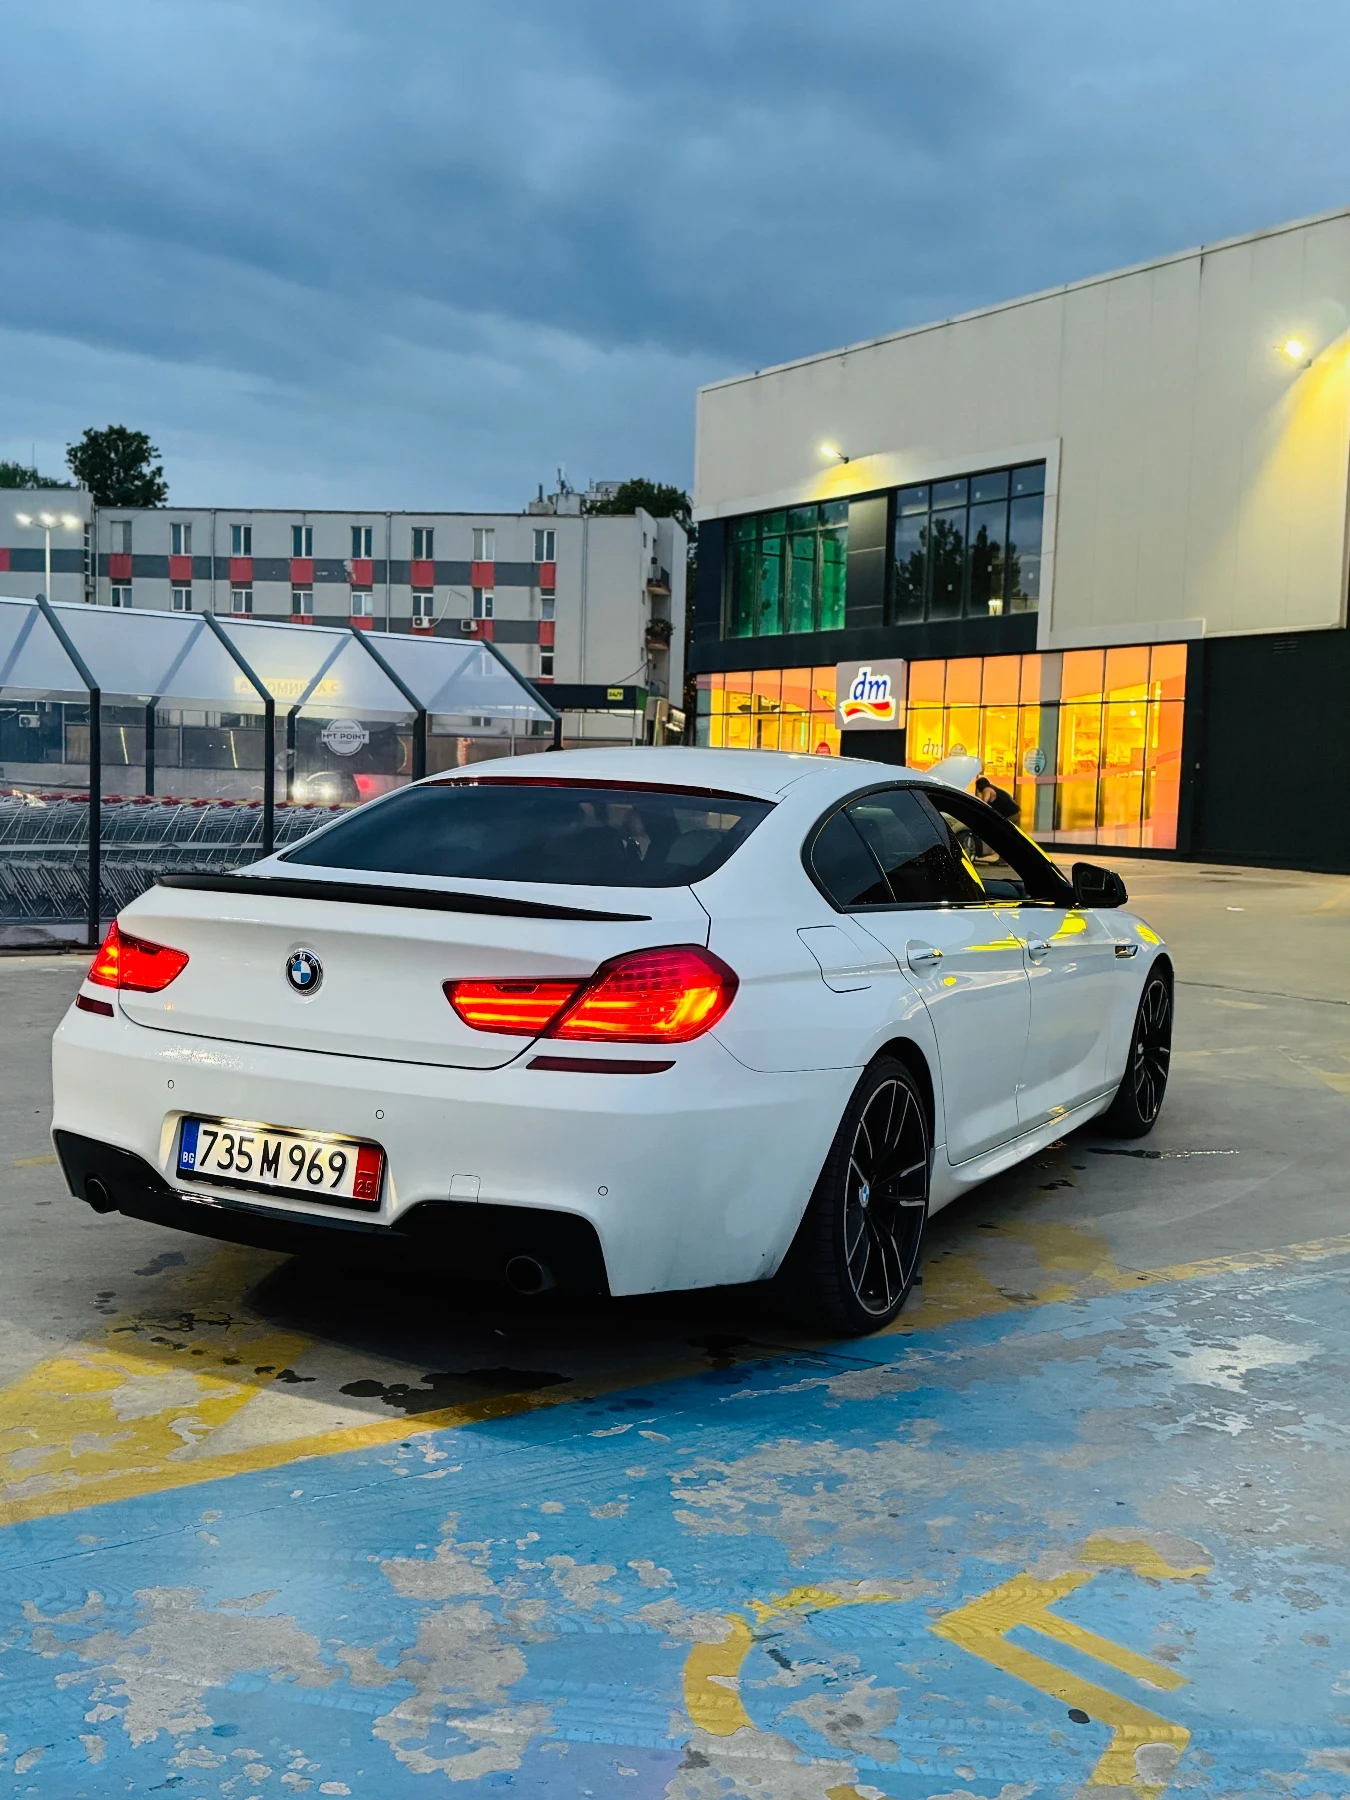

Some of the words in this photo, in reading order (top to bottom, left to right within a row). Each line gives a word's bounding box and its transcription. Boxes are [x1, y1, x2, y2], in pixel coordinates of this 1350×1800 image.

[853, 671, 888, 701] dm
[182, 1151, 195, 1163] BG
[199, 1129, 255, 1173] 735
[259, 1139, 282, 1179] M
[288, 1144, 347, 1188] 969
